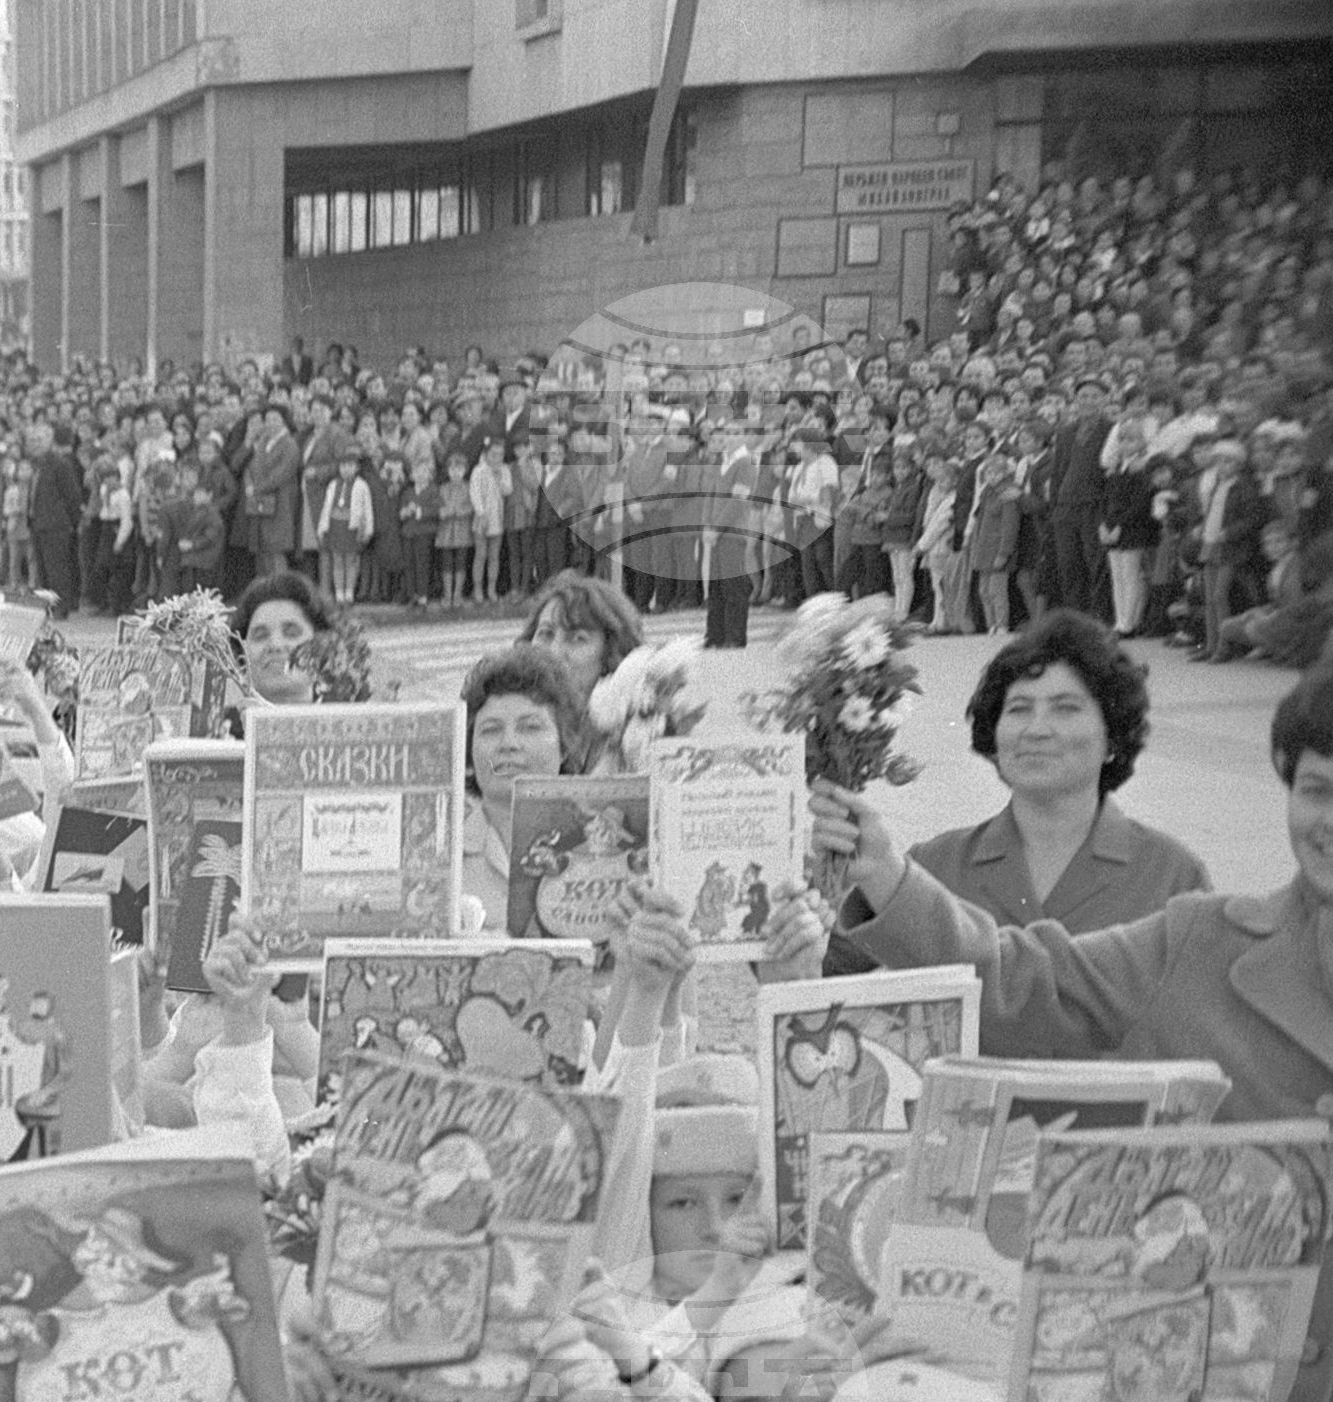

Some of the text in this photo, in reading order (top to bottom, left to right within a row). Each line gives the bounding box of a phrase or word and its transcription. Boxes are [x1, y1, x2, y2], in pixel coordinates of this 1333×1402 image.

[299, 745, 410, 786] СКАЗКИ
[561, 878, 629, 902] КОТ
[899, 1267, 979, 1299] КОТ
